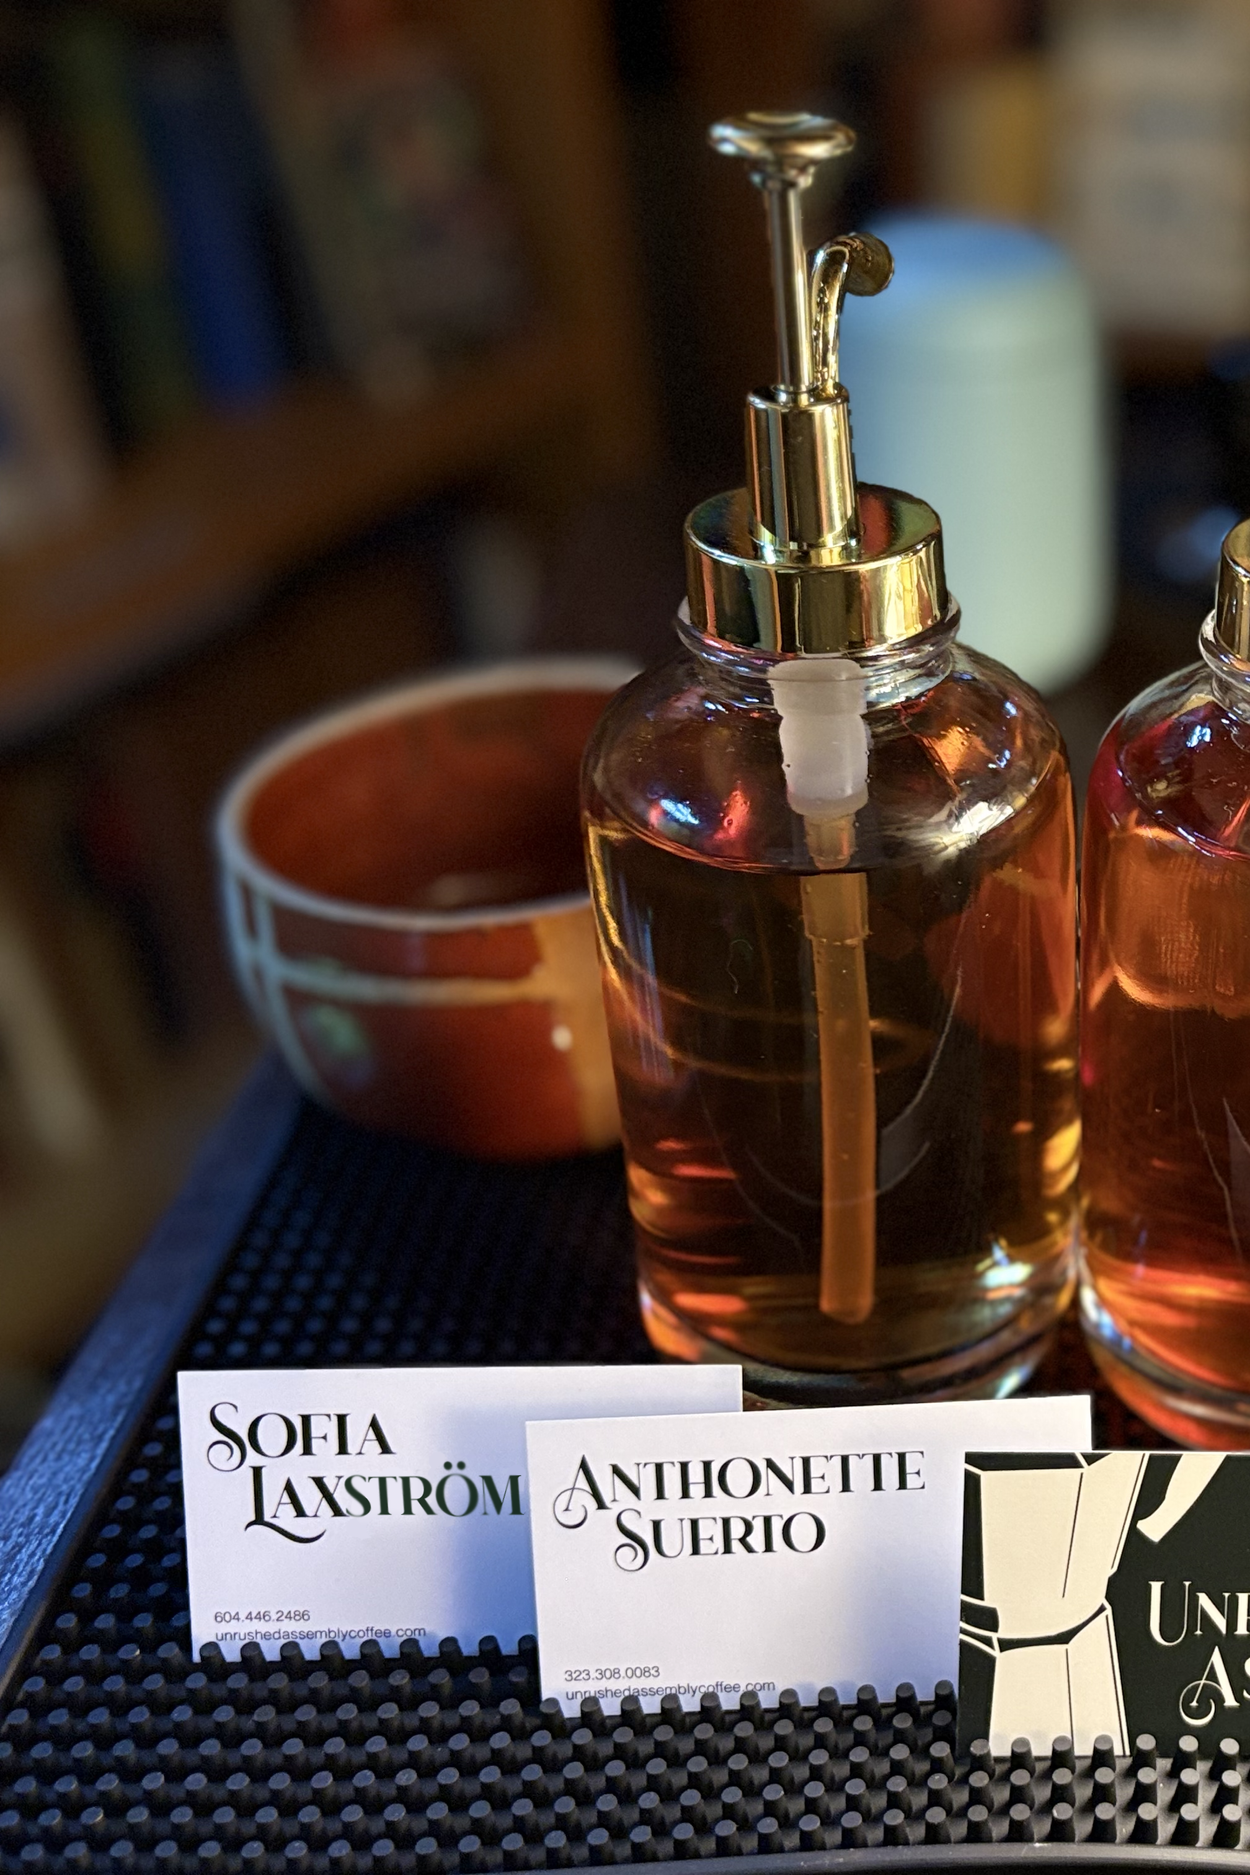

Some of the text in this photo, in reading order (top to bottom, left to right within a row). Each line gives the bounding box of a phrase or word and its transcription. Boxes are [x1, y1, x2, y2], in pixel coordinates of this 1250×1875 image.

[207, 1402, 396, 1472] SOFIA
[244, 1461, 525, 1543] LAXSTRÖM
[552, 1451, 925, 1529] ANTHONETTE
[614, 1508, 827, 1572] SUERTO
[214, 1610, 310, 1623] 604.446.2486
[215, 1626, 426, 1641] unrushedassemblycoffee.com
[564, 1666, 660, 1681] 323.308.0083
[565, 1681, 775, 1700] unrushedassemblycoffee.com
